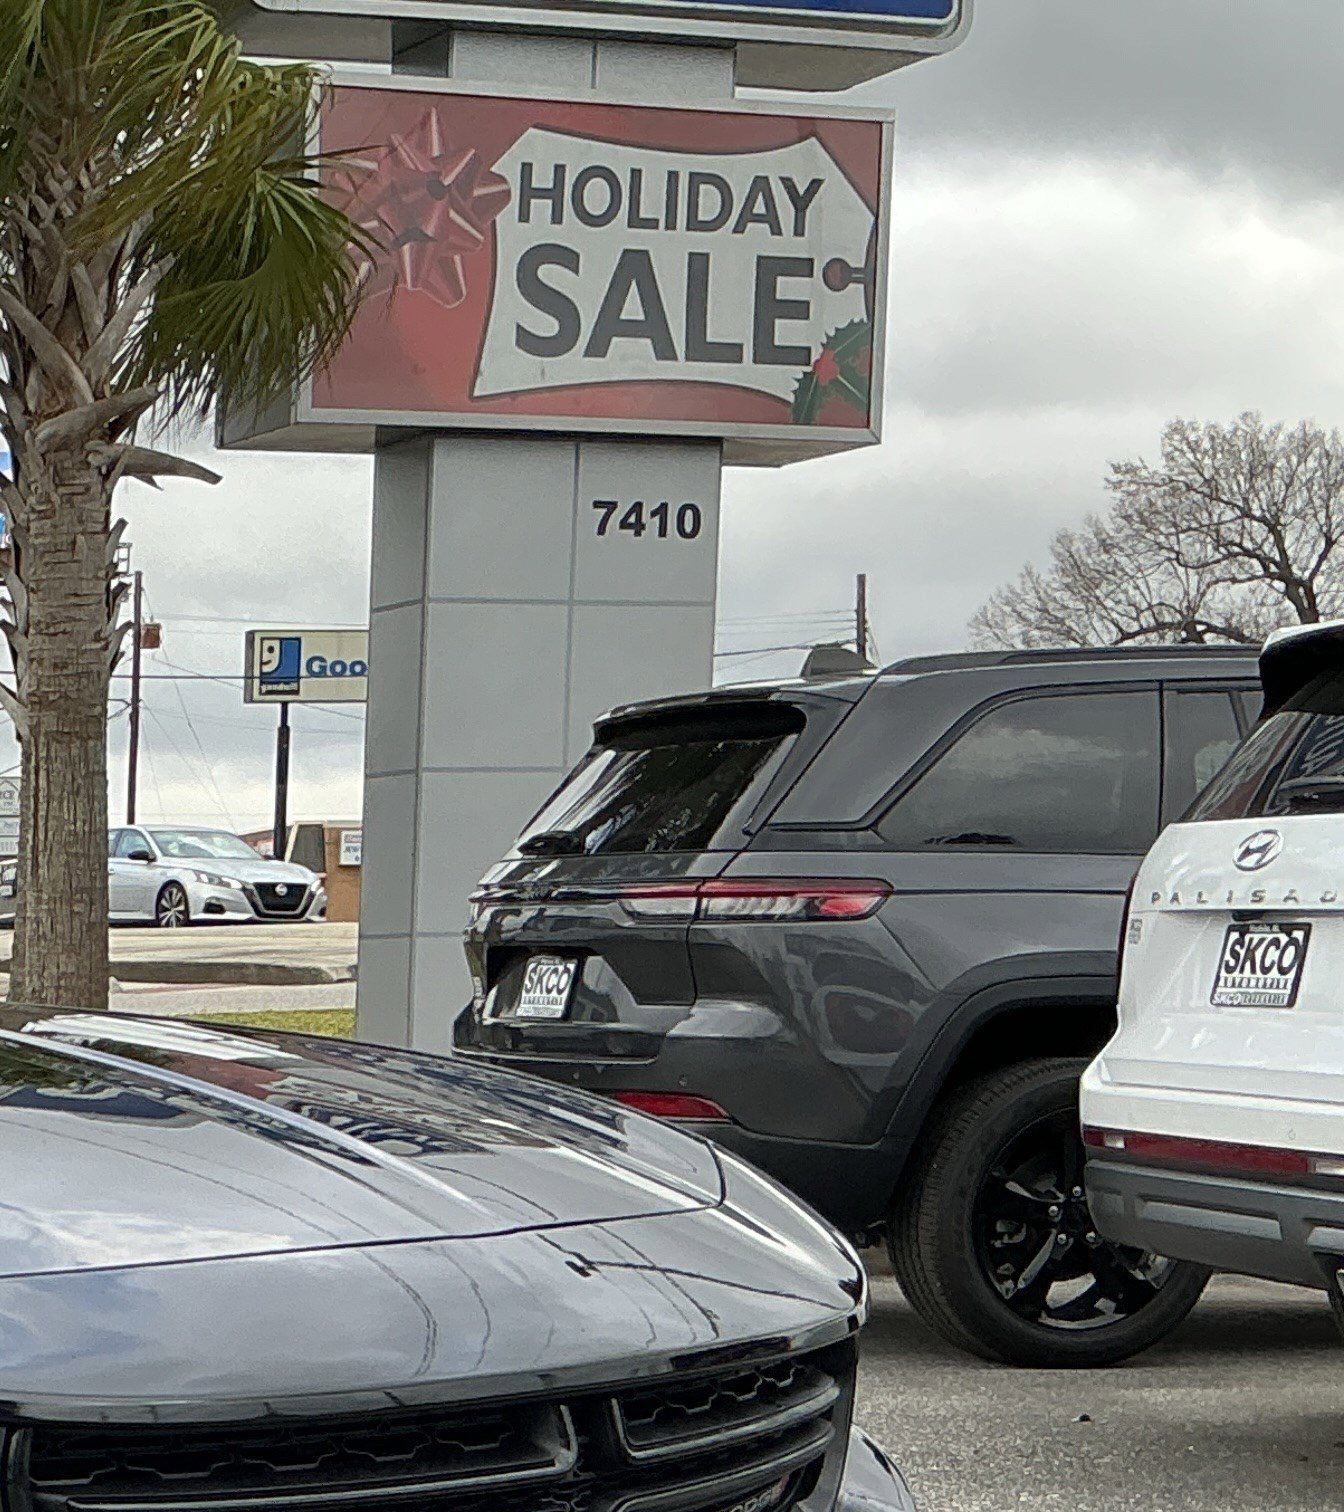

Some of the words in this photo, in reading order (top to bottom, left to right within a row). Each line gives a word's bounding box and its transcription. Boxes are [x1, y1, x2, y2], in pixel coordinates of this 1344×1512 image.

[517, 161, 826, 238] HOLIDAY
[514, 243, 814, 365] SALE
[592, 500, 702, 539] 7410
[1224, 936, 1300, 976] SKCO
[525, 965, 572, 995] SKCO
